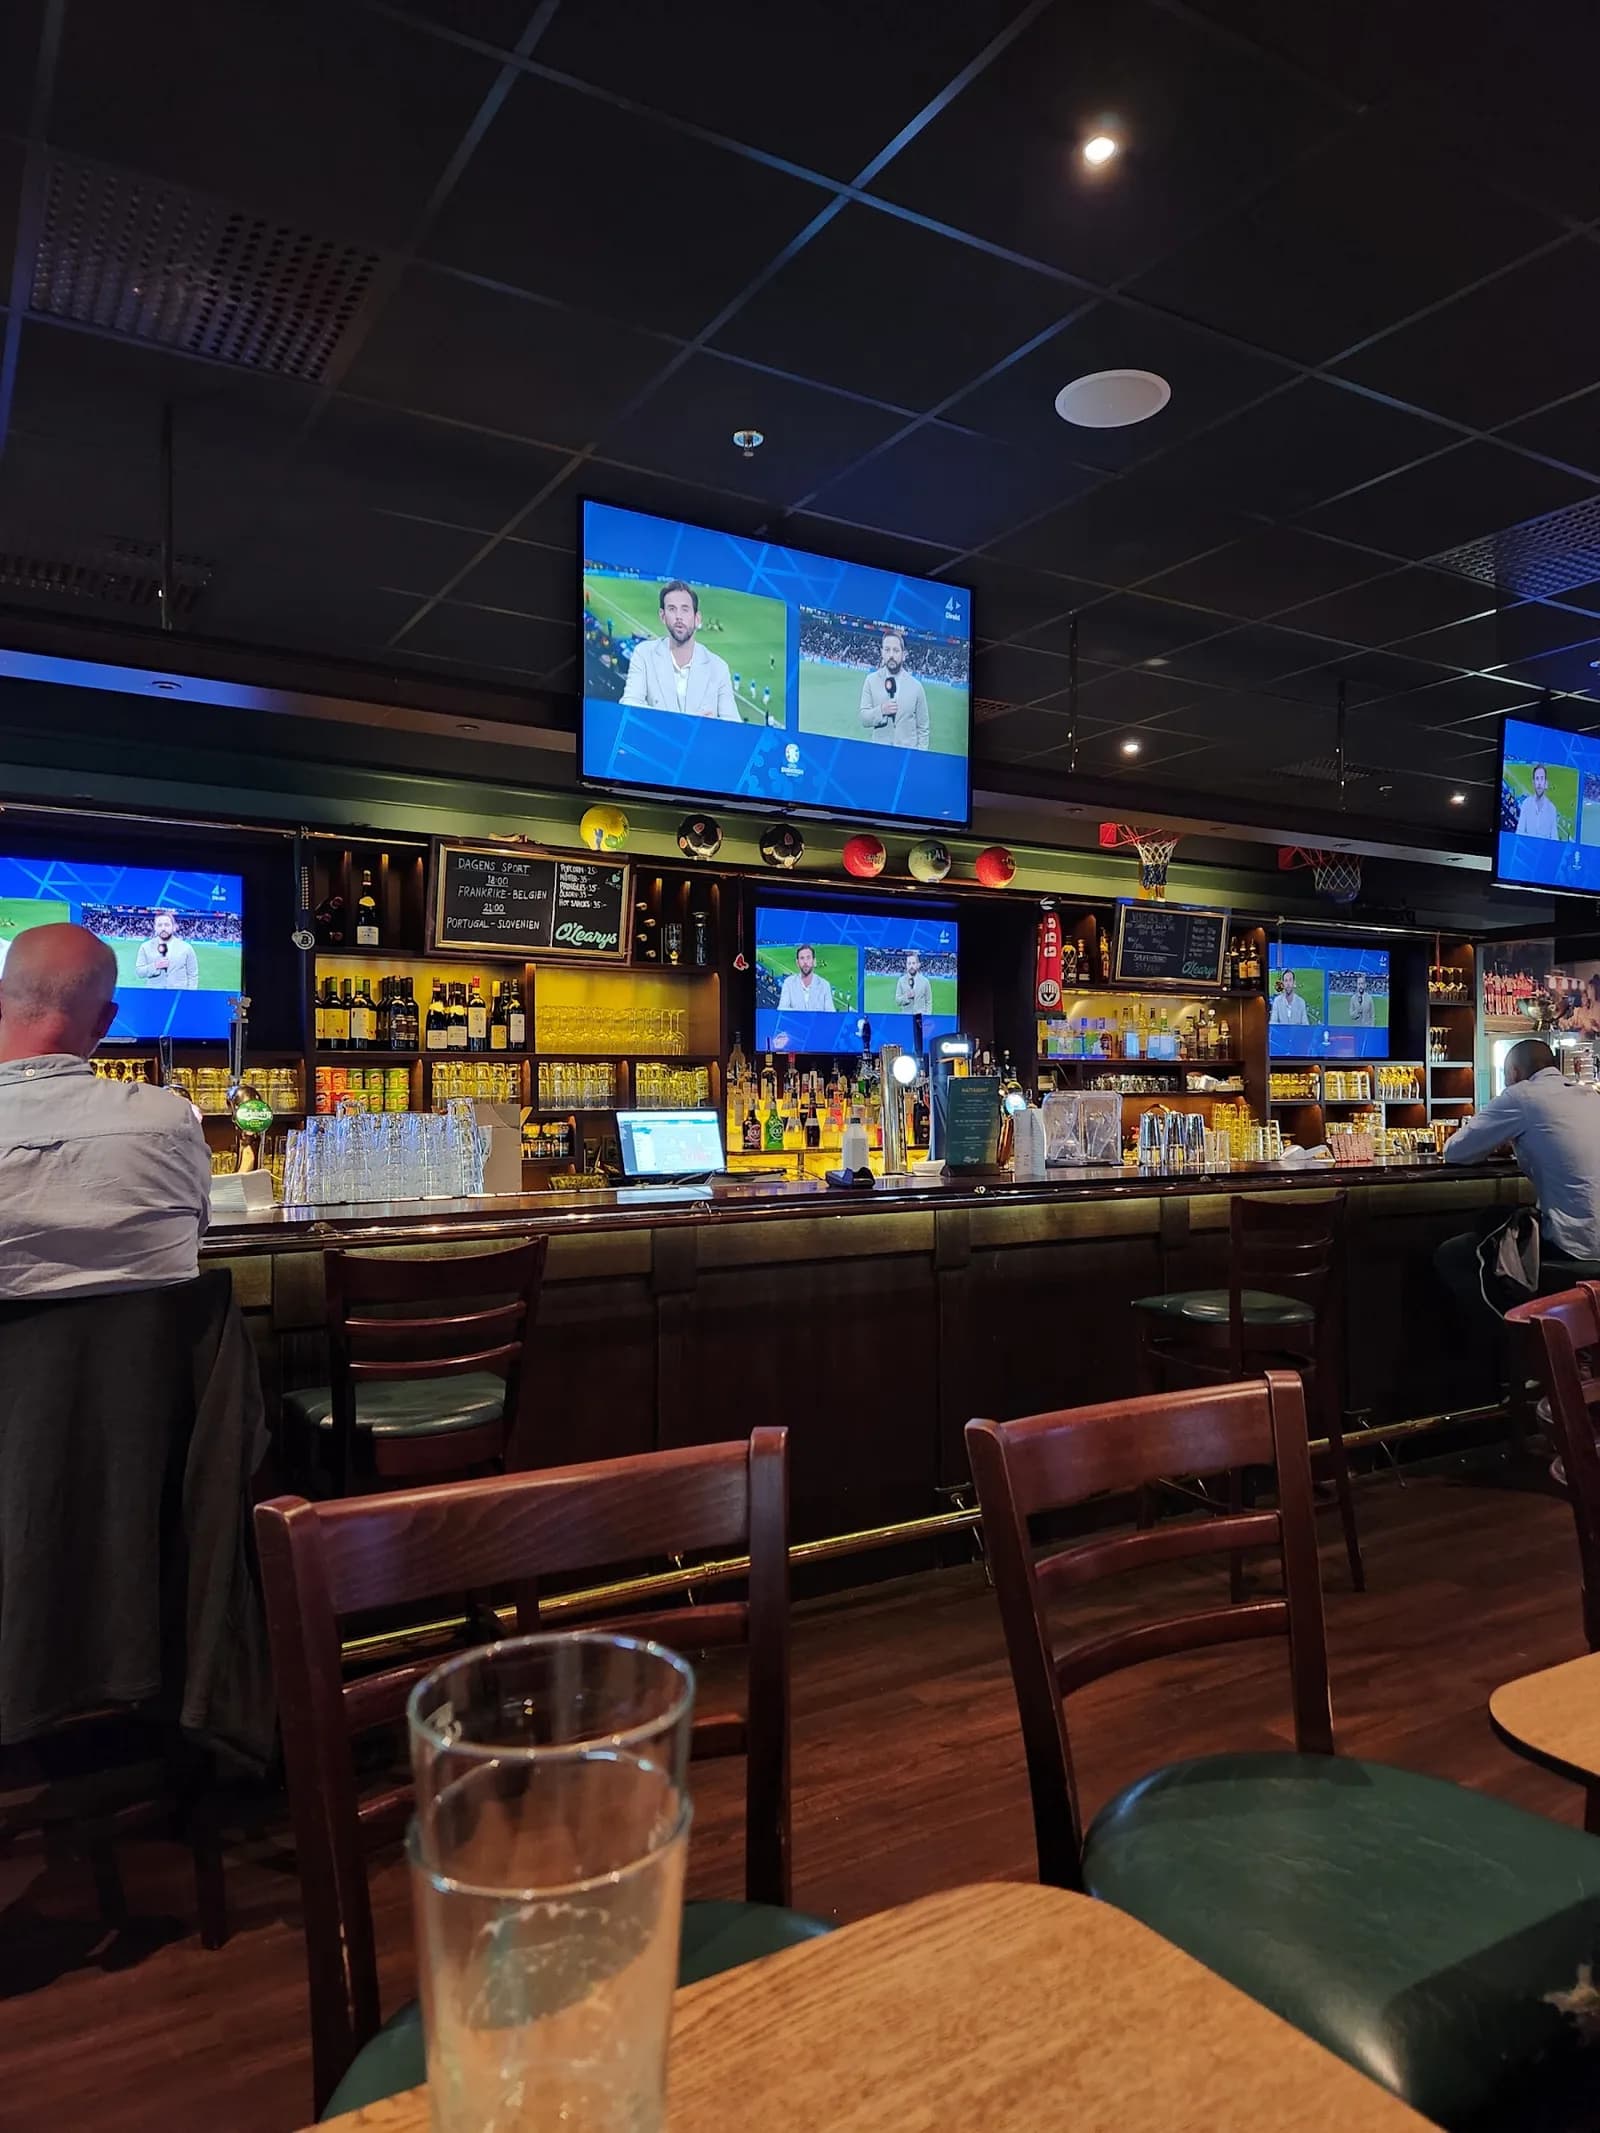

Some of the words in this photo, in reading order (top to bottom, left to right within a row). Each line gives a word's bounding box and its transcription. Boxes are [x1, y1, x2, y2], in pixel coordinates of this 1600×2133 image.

[458, 857, 496, 872] DAGENS
[501, 862, 531, 874] SPORT
[555, 922, 618, 949] O'Learys
